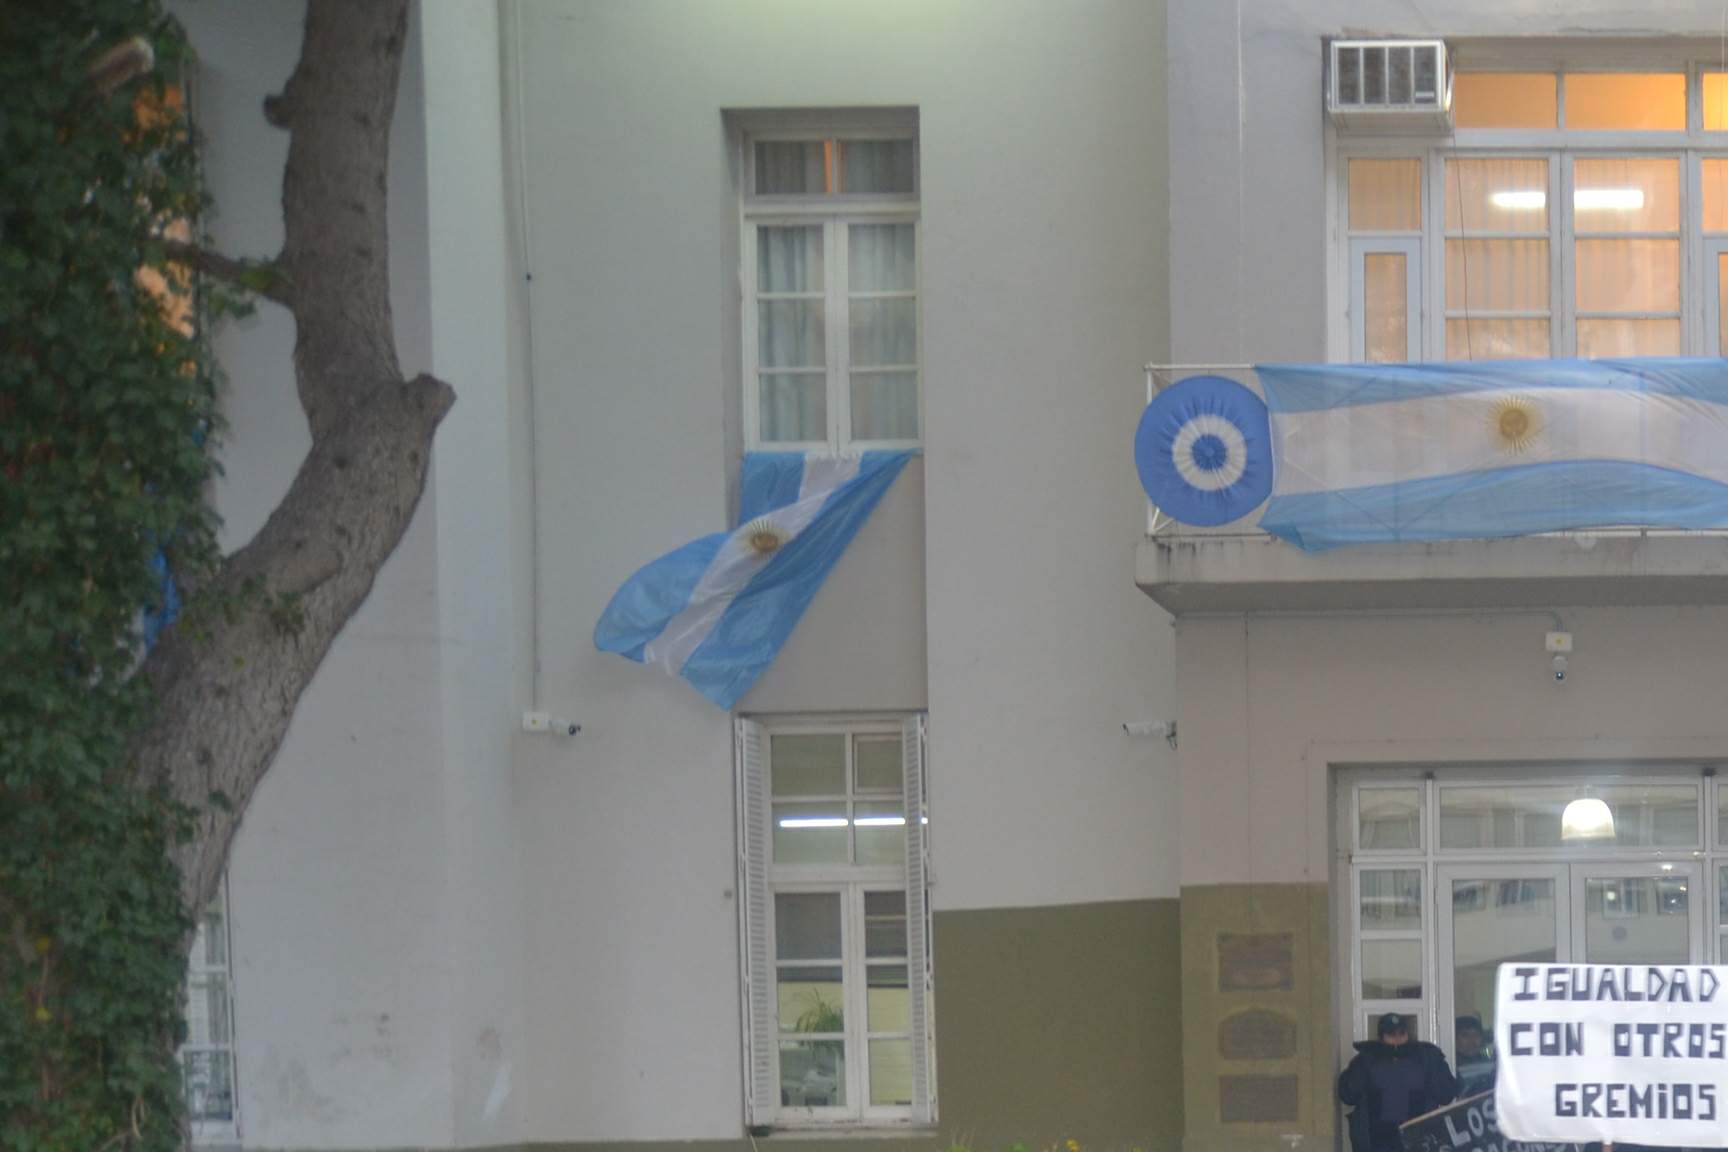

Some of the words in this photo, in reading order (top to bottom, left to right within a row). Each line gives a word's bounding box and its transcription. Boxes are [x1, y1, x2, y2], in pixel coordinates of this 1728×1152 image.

[1513, 966, 1719, 1002] IGUALDAD
[1509, 1021, 1585, 1059] CON
[1613, 1022, 1728, 1060] OTROS
[1444, 1098, 1498, 1144] LOS
